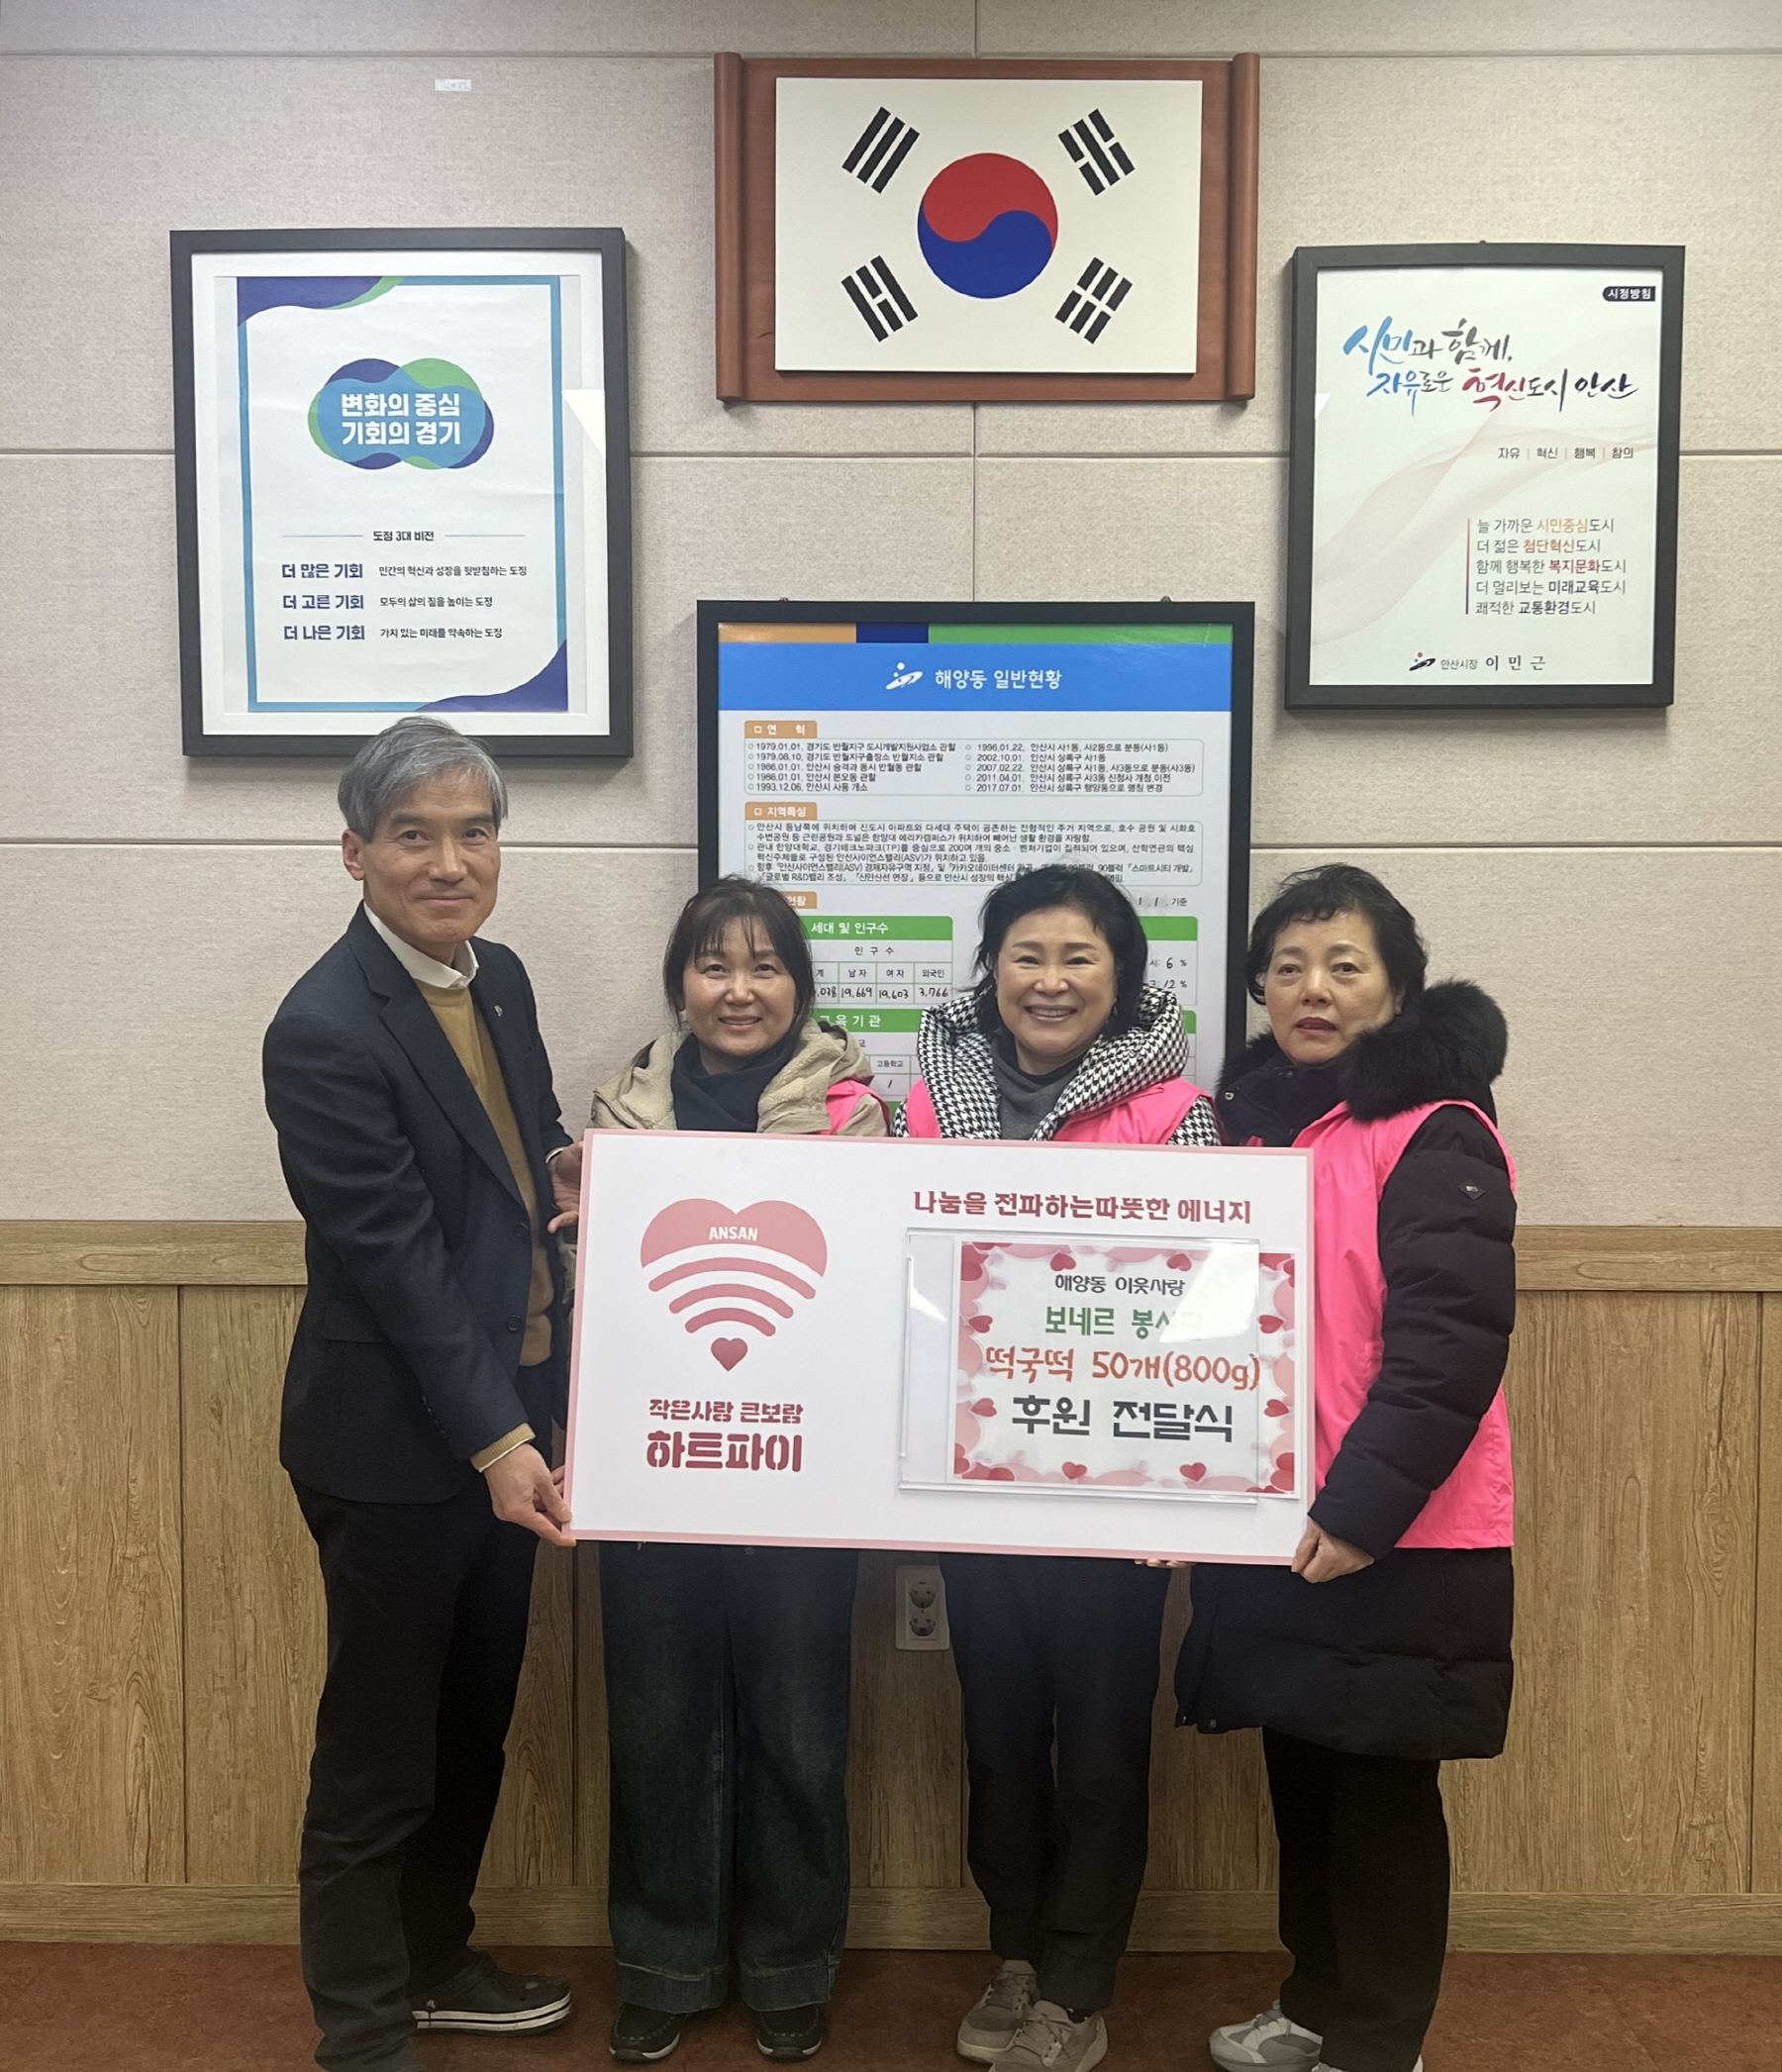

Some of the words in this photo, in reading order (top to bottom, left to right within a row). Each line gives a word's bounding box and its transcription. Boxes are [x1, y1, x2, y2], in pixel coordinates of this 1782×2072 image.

[1607, 287, 1652, 301] 시정방침
[1342, 315, 1442, 375] 시민과
[1366, 368, 1453, 417] 자유로운
[1461, 367, 1568, 413] 혁신도시
[1574, 371, 1638, 400] 안산
[342, 393, 409, 417] 변화의
[415, 393, 459, 417] 중심
[342, 421, 410, 444] 기회의
[416, 422, 460, 444] 경기
[1497, 447, 1521, 459] 자유
[1536, 447, 1558, 459] 혁신
[1574, 447, 1596, 459] 행복
[1611, 447, 1634, 459] 창의
[1477, 519, 1490, 534] 늘
[1494, 518, 1534, 534] 가까운
[1536, 518, 1614, 534] 시민중심도시
[373, 531, 393, 542] 도정
[395, 531, 412, 542] 3대
[414, 531, 434, 542] 비전
[1477, 540, 1489, 553] 더
[1494, 539, 1520, 553] 젊은
[1523, 539, 1601, 553] 첨단혁신도시
[281, 563, 296, 578] 더
[301, 563, 330, 578] 많은
[334, 563, 363, 578] 기회
[407, 565, 434, 576] 혁신과
[436, 565, 461, 576] 성장을
[464, 565, 507, 576] 뒷받침하는
[509, 565, 527, 576] 도정
[1476, 559, 1502, 574] 함께
[1506, 559, 1545, 574] 행복한
[1548, 559, 1626, 574] 복지문화도시
[1476, 580, 1488, 595] 더
[1548, 579, 1626, 595] 미래교육도시
[283, 595, 297, 610] 더
[302, 595, 331, 610] 고른
[335, 595, 364, 610] 기회
[380, 597, 406, 607] 모두의
[408, 597, 426, 607] 삶의
[428, 596, 446, 607] 질을
[446, 597, 473, 607] 높이는
[475, 596, 493, 607] 도정
[1475, 601, 1515, 615] 쾌적한
[1518, 600, 1595, 615] 교통환경도시
[284, 626, 298, 641] 더
[303, 625, 332, 641] 나은
[336, 625, 365, 641] 기회
[380, 629, 398, 639] 가치
[400, 628, 418, 639] 있는
[420, 628, 446, 639] 미래를
[447, 628, 483, 639] 약속하는
[485, 628, 502, 639] 도정
[1440, 659, 1478, 670] 안산시장
[935, 669, 987, 689] 해양동
[994, 669, 1062, 690] 일반현황
[806, 742, 831, 751] 경기도
[1031, 743, 1055, 752] 안산시
[806, 752, 831, 761] 경기도
[1031, 753, 1055, 762] 안산시
[806, 763, 831, 772] 안산시
[1031, 763, 1055, 772] 안산시
[806, 773, 831, 782] 안산시
[1030, 773, 1054, 783] 안산시
[806, 783, 831, 792] 안산시
[833, 783, 849, 792] 사동
[851, 783, 868, 792] 개소
[1030, 783, 1054, 792] 안산시
[767, 806, 806, 818] 지역특성
[935, 853, 966, 862] 위치하고
[1171, 898, 1188, 907] 기준
[811, 922, 834, 934] 세대
[839, 922, 849, 935] 및
[854, 922, 889, 935] 인구수
[922, 969, 944, 978] 외국인
[914, 1191, 987, 1217] 나눔을
[1177, 1199, 1250, 1224] 에너지
[709, 1227, 758, 1244] ANSAN
[1054, 1274, 1107, 1293] 해양동
[1115, 1275, 1186, 1297] 이웃사랑
[1044, 1306, 1115, 1335] 보네르
[985, 1345, 1074, 1383] 떡국떡
[1092, 1350, 1260, 1391] 50개(800g)
[649, 1399, 734, 1423] 작은사랑
[740, 1402, 804, 1424] 큰보람
[1012, 1395, 1090, 1435] 후원
[1113, 1401, 1233, 1442] 전달식
[646, 1430, 802, 1472] 하트파이
